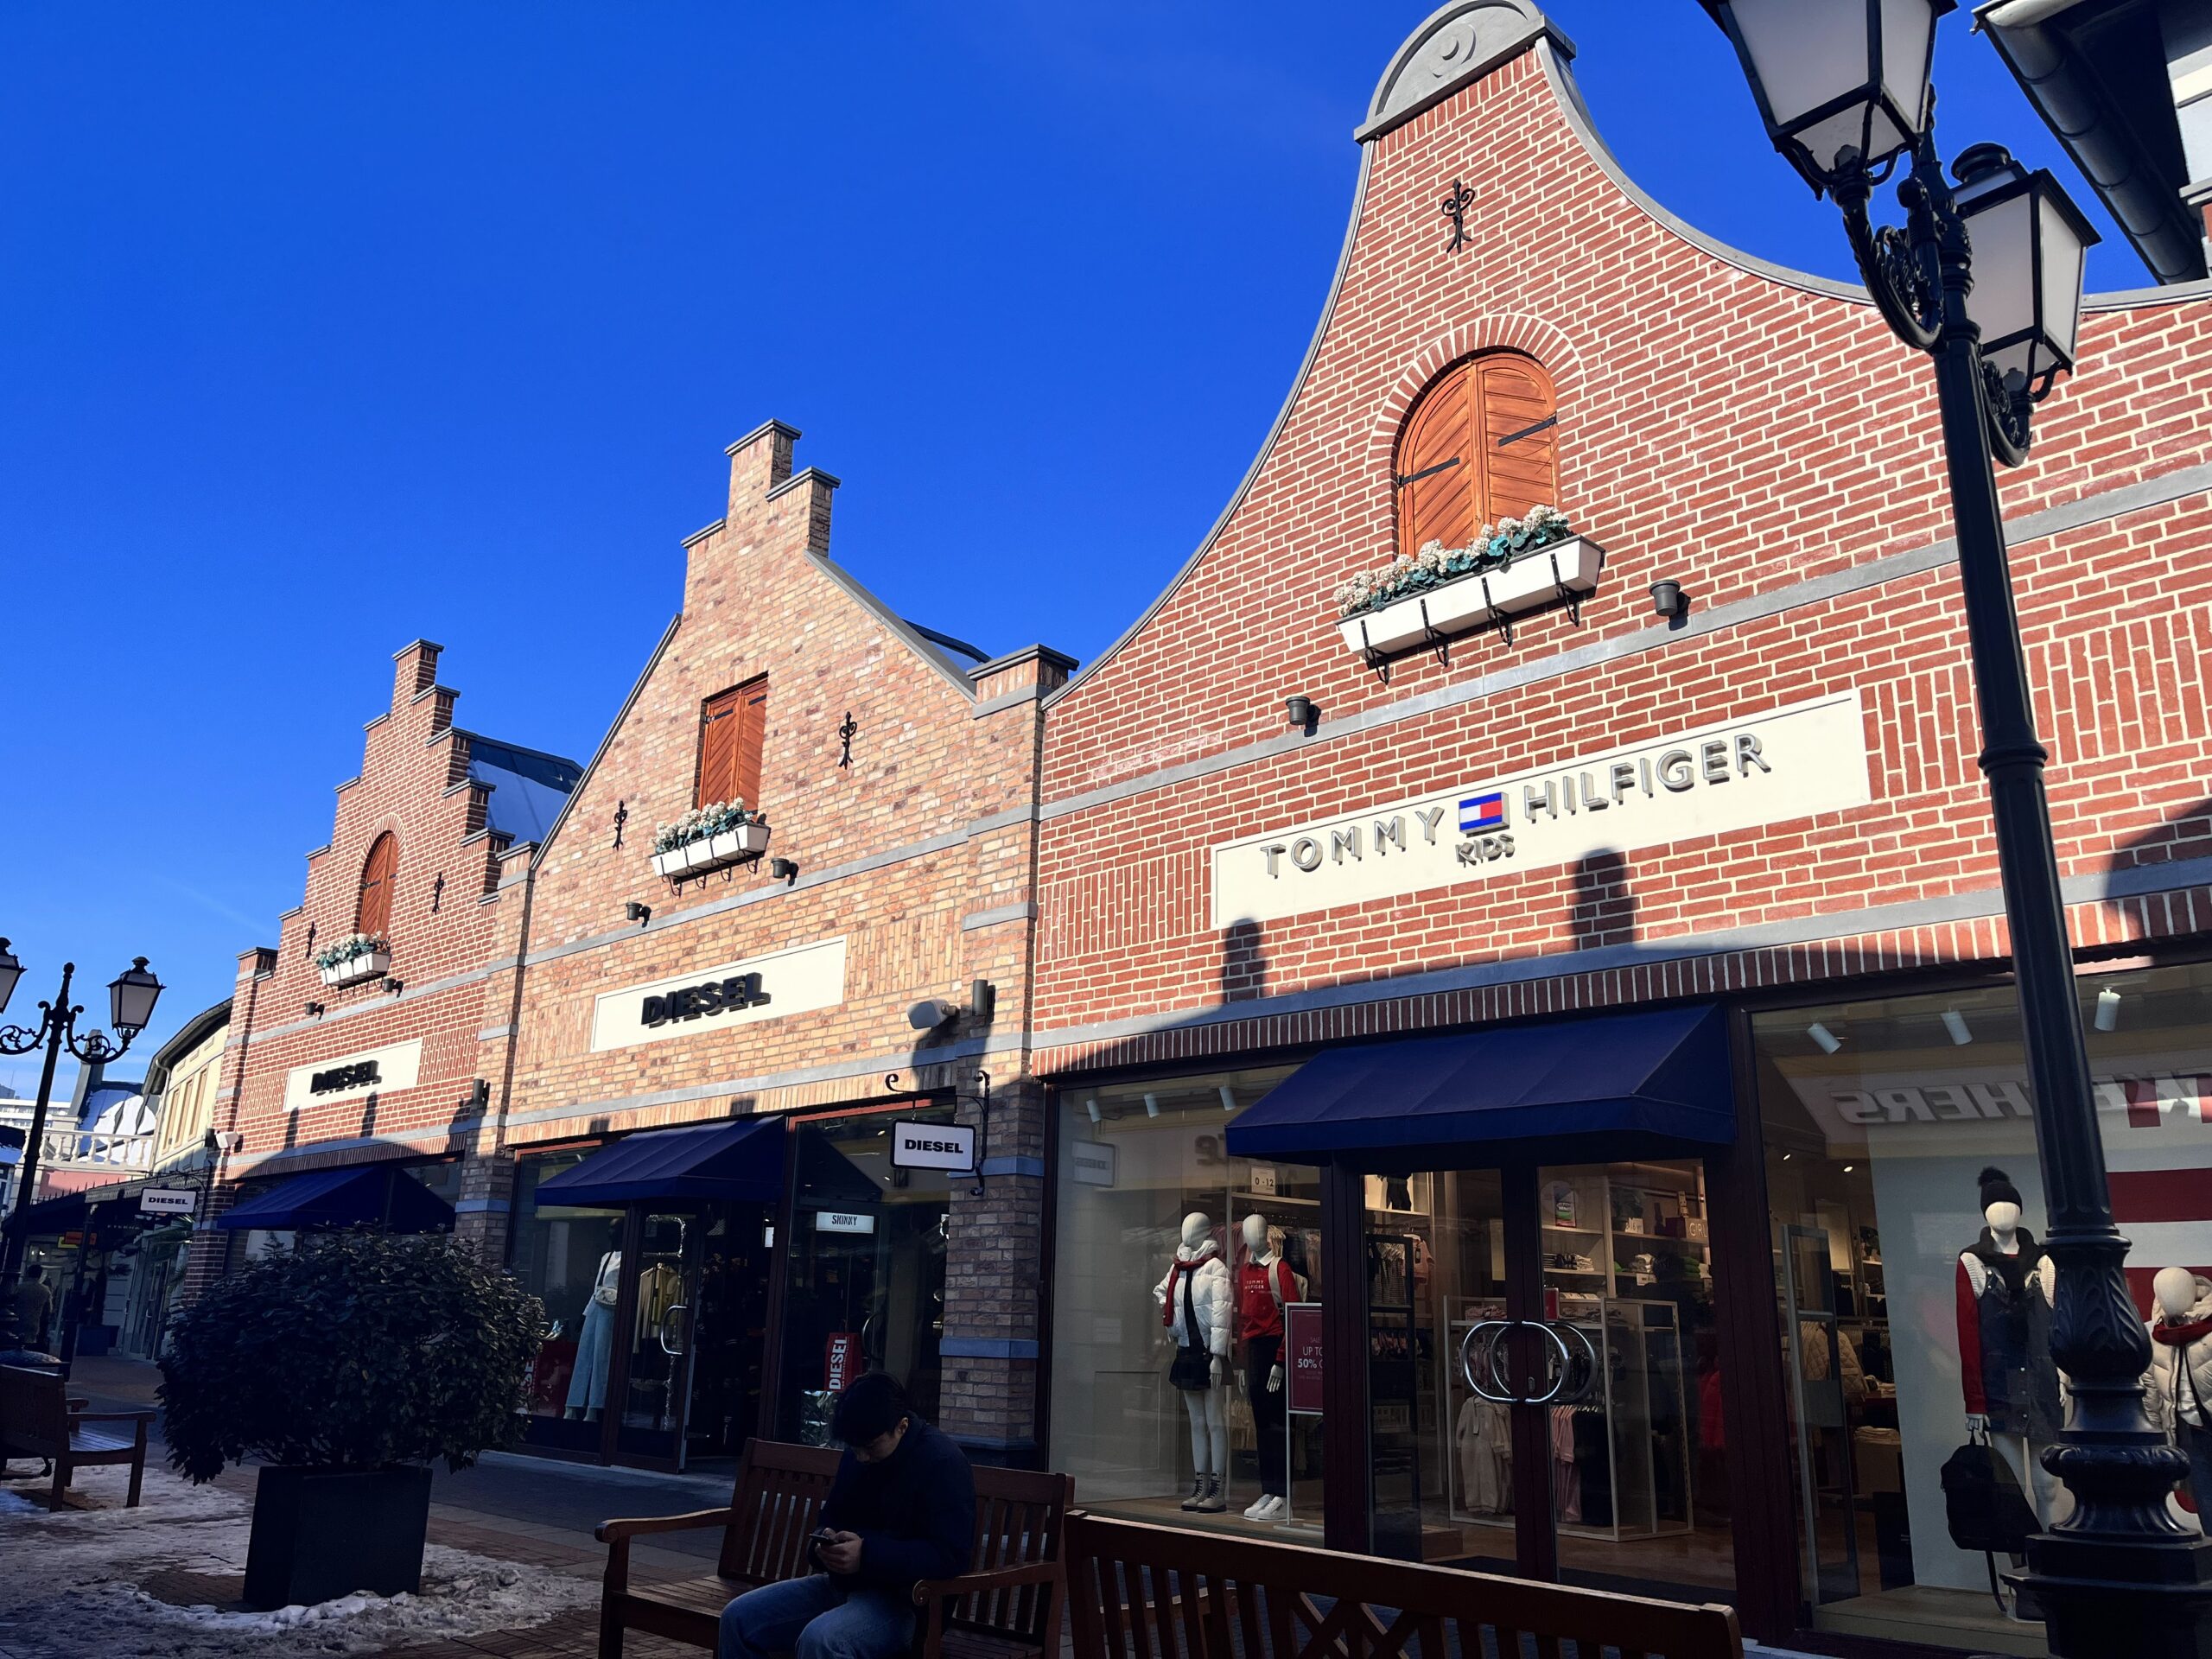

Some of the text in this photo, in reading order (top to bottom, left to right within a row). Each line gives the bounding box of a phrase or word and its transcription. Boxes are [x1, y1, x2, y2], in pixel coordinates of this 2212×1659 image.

[1260, 733, 1771, 878] TOMMY HILFIGER
[1455, 833, 1515, 867] KIDS
[641, 973, 769, 1026] DIESEL
[310, 1059, 380, 1095] DIESEL
[905, 1139, 963, 1154] DIESEL
[831, 1214, 858, 1226] SKINNY
[830, 1336, 848, 1390] DIESEL
[1297, 1358, 1318, 1369] 50%
[1302, 1346, 1313, 1357] UP
